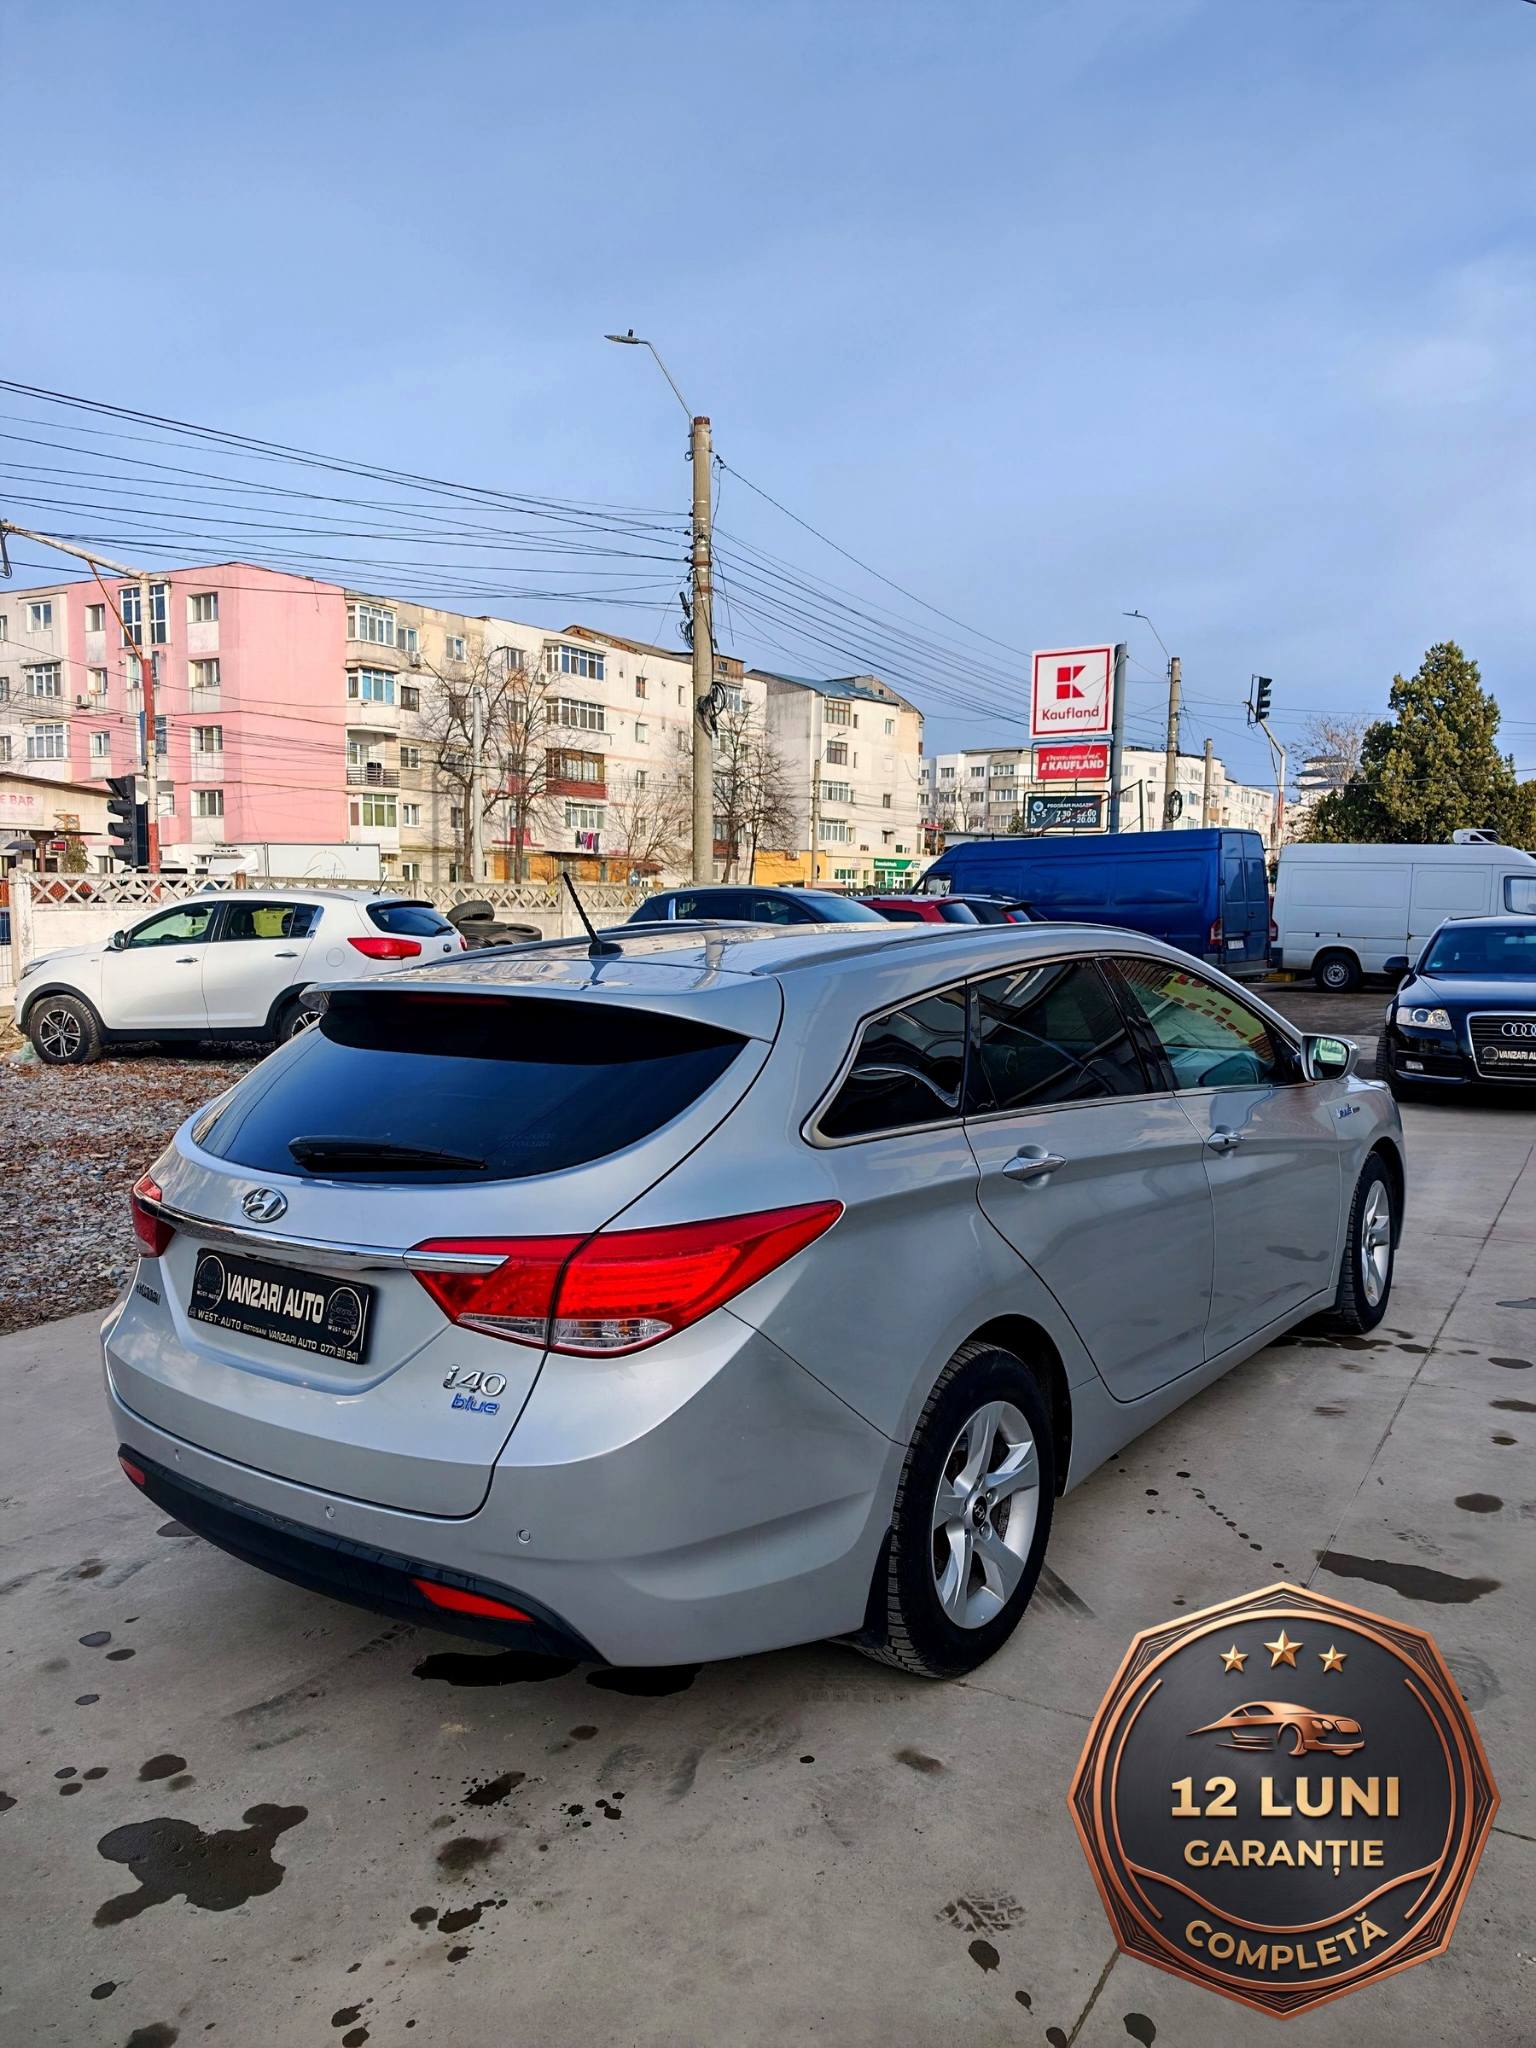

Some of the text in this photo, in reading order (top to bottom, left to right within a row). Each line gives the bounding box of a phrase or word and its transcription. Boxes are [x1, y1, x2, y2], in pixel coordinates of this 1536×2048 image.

[1042, 705, 1100, 721] Kaufland
[1049, 759, 1105, 771] KAUFLAND
[9, 795, 34, 806] BAR
[1499, 1050, 1528, 1060] VANZARI
[227, 1272, 325, 1324] VANZARI AUTO
[198, 1309, 242, 1330] WEST-AUTO
[268, 1329, 297, 1346] VANZARI
[297, 1337, 318, 1350] AUTO
[320, 1343, 336, 1356] 0771
[336, 1347, 346, 1359] 311
[346, 1350, 359, 1362] 941
[442, 1364, 507, 1397] i40
[450, 1392, 501, 1415] blue
